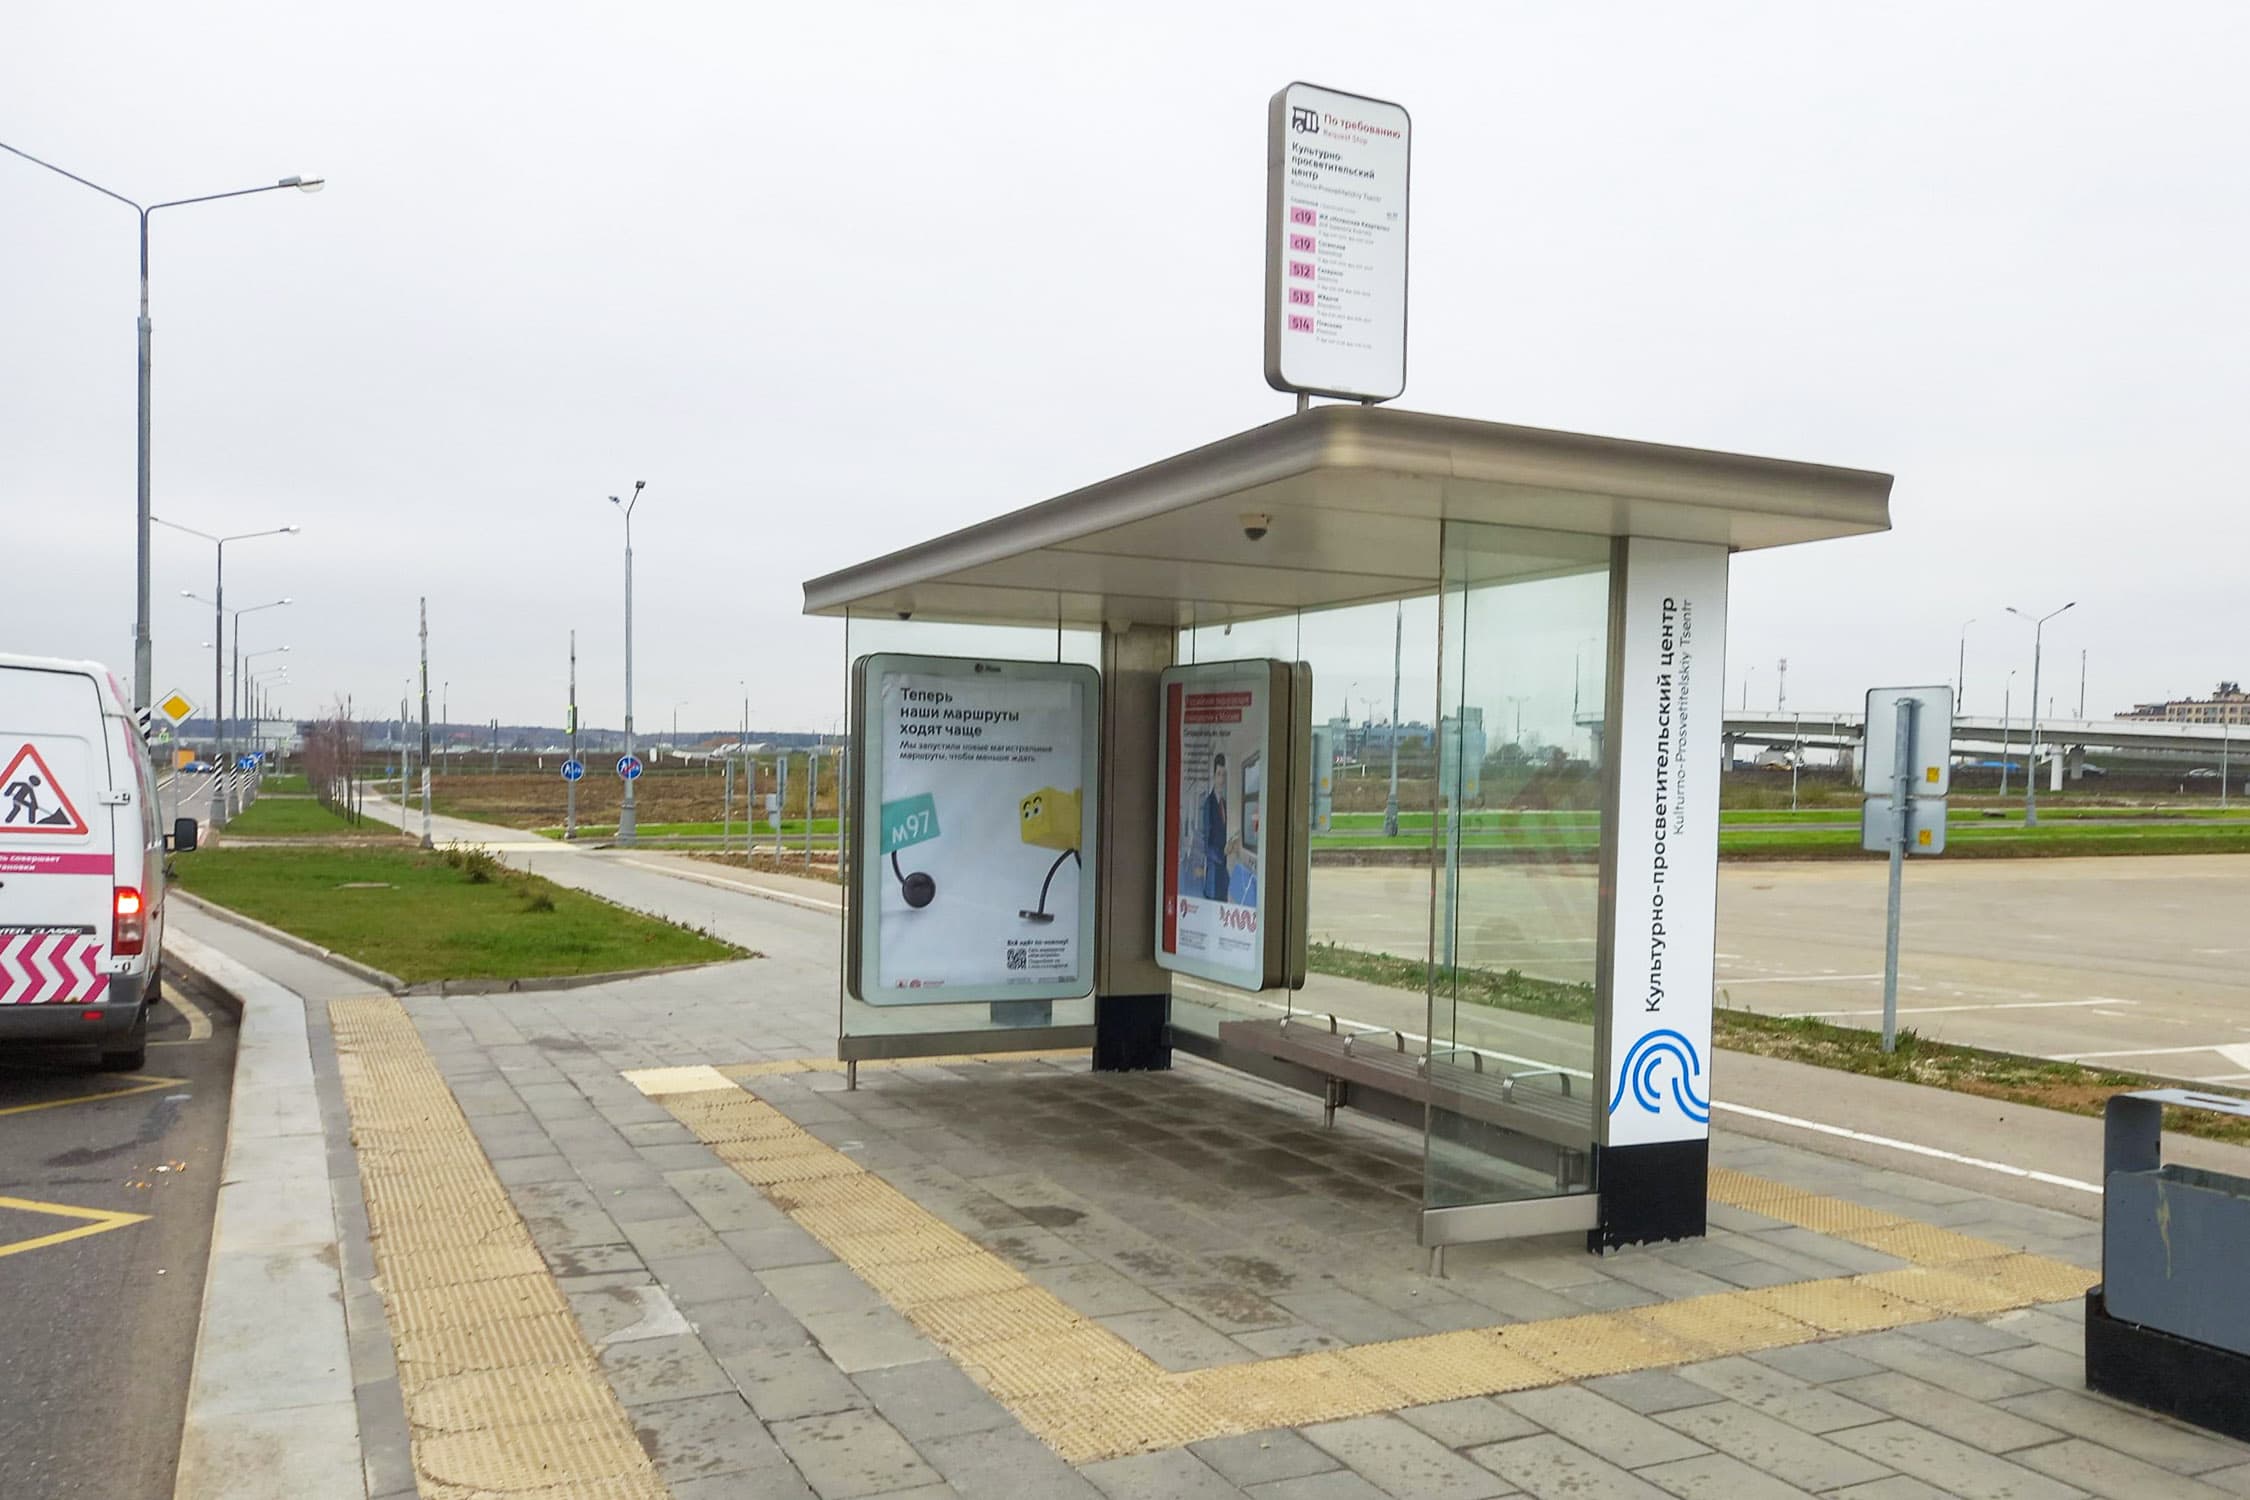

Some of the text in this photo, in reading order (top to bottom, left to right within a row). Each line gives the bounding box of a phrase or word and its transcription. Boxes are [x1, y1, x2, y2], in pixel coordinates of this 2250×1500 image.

[1323, 113, 1338, 126] По
[1291, 167, 1319, 181] центр
[1293, 265, 1311, 278] 512
[900, 687, 953, 704] Теперь
[900, 708, 1020, 723] наши маршруты
[1673, 599, 1693, 835] Kulturno-Prosvetitelskiy Tsentr
[900, 724, 983, 738] ходят чаще
[900, 740, 916, 750] Мы
[1646, 597, 1677, 1012] Культурно-просветительский центр
